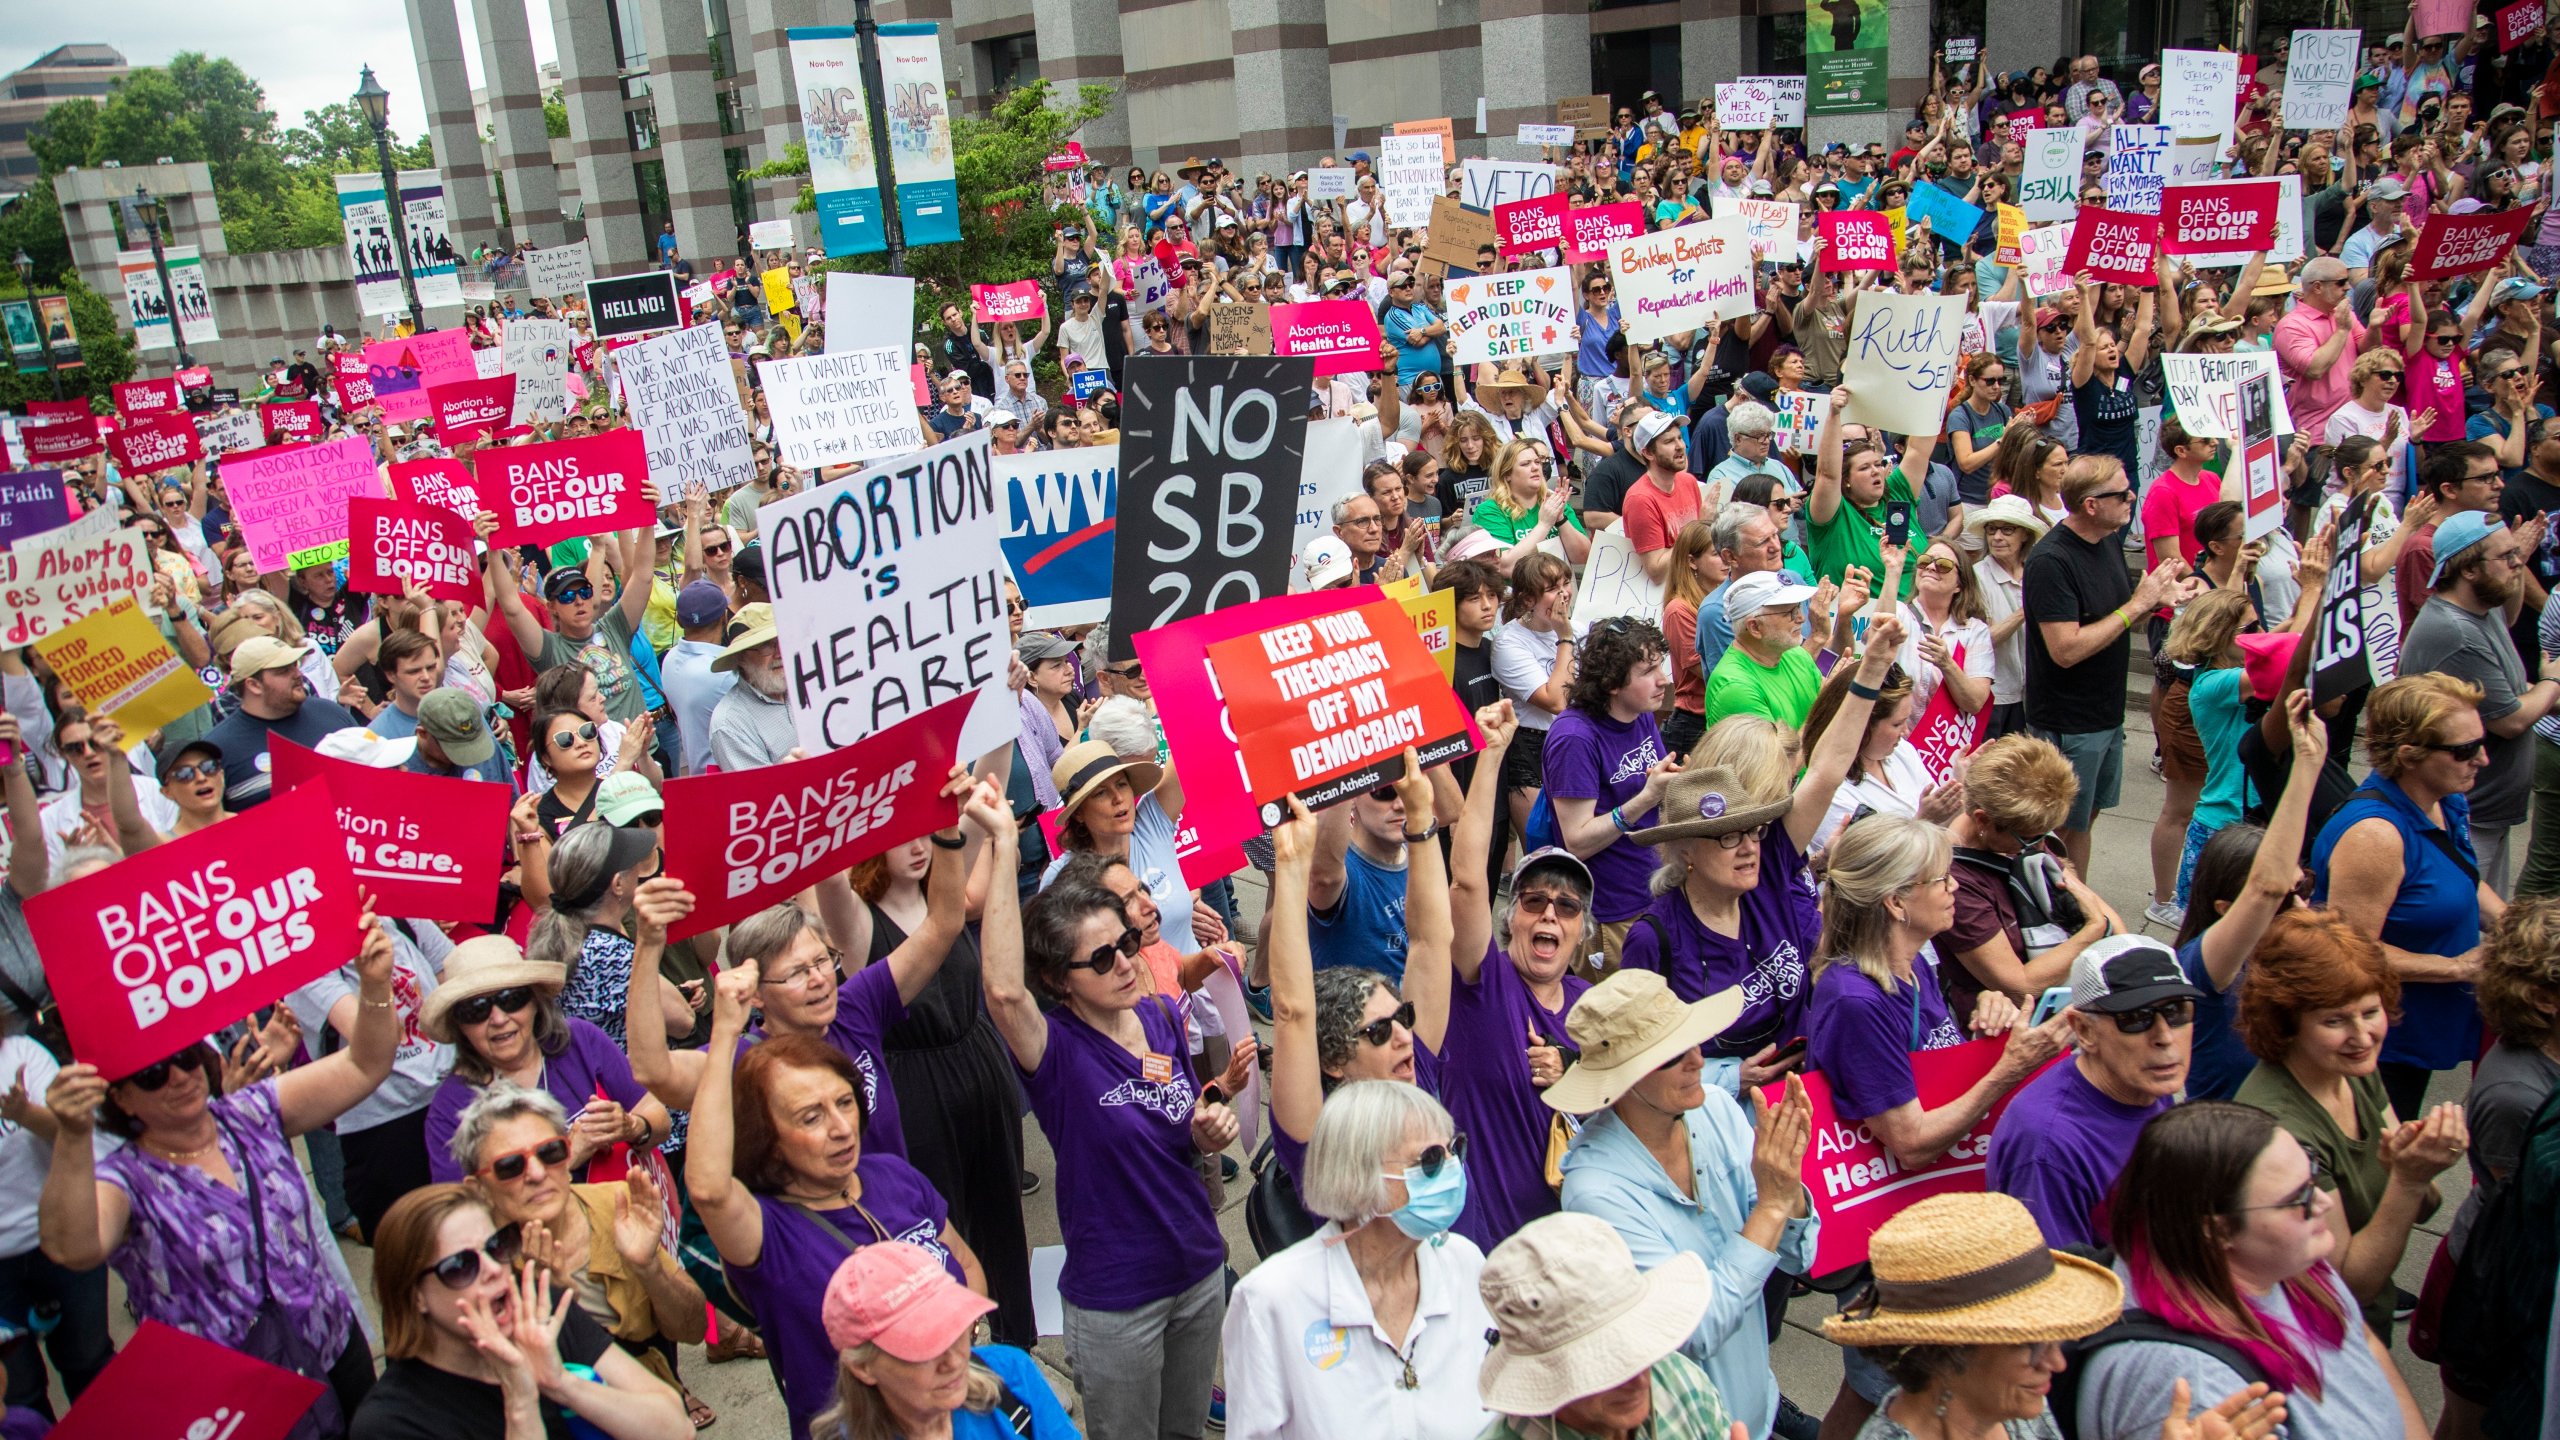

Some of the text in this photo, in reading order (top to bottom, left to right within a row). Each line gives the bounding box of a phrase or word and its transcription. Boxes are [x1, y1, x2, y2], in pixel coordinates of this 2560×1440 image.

[2295, 35, 2359, 60] TRUST
[809, 60, 843, 68] Now Open
[2292, 62, 2352, 81] WOMEN
[808, 87, 857, 117] NC
[1717, 84, 1773, 106] HER BODY
[1731, 101, 1751, 111] HER
[1721, 112, 1765, 124] CHOICE
[2285, 103, 2347, 123] DOCTORS
[1384, 136, 1440, 150] It's so bad
[2116, 126, 2171, 151] ALL I
[1388, 152, 1441, 166] that even the
[2110, 150, 2162, 174] WANT
[1385, 168, 1445, 185] INTROVERTS
[1388, 185, 1419, 197] are out
[1468, 168, 1553, 208] VETO
[2023, 175, 2073, 203] YIKES
[2110, 176, 2127, 193] FOR
[2108, 192, 2143, 208] DAY IS
[2180, 197, 2229, 213] BANS
[350, 205, 387, 226] SIGNS TIMES
[2178, 210, 2259, 228] OFF OUR
[2178, 225, 2250, 243] BODIES
[1620, 235, 1725, 277] Binkley Baptists
[1486, 279, 1525, 298] KEEP
[1671, 269, 1695, 285] for
[602, 295, 665, 319] HELL NO!
[1638, 274, 1748, 318] Reproductive Health
[1213, 306, 1253, 317] WOMENS
[1216, 316, 1250, 326] RIGHTS
[1450, 299, 1569, 338] REPRODUCTIVE
[1212, 333, 1240, 342] HUMAN
[1221, 325, 1233, 333] ARE
[1289, 319, 1351, 338] Abortion is
[1290, 333, 1370, 352] Health Care.
[1487, 320, 1532, 340] CARE
[1853, 306, 1953, 370] Ruth
[417, 337, 458, 352] BELIEVE
[420, 351, 446, 364] DATA
[619, 325, 720, 368] ROE WADE
[1488, 337, 1534, 356] SAFE!
[426, 359, 471, 376] DOCTORS
[628, 345, 726, 386] WAS NOT THE
[775, 351, 901, 383] IF I WANTED THE
[637, 369, 717, 404] BEGINNING
[799, 378, 887, 405] GOVERNMENT
[1078, 380, 1104, 389] 12-WEEK
[636, 388, 734, 427] OF ABORTIONS.
[790, 402, 899, 432] IN MY UTERUS
[656, 403, 745, 444] IT WAS THE
[1170, 384, 1278, 464] NO
[123, 429, 161, 448] BANS
[126, 432, 188, 458] OFF OUR
[646, 427, 750, 471] END OF WOMEN
[789, 428, 923, 462] I'D A SENATOR
[131, 446, 187, 468] BODIES
[252, 444, 344, 479] ABORTION
[677, 458, 723, 479] DYING
[232, 459, 373, 504] A PERSONAL DECISION
[508, 456, 579, 490] BANS
[713, 466, 755, 488] THEM!
[2, 484, 54, 502] Faith
[240, 500, 299, 524] BETWEEN
[303, 496, 312, 509] A
[317, 481, 366, 504] WOMAN
[510, 472, 625, 508] OFF OUR
[286, 517, 310, 532] HER
[515, 495, 617, 527] BODIES
[771, 443, 994, 599] ABORTION
[1147, 472, 1264, 563] SB
[376, 516, 443, 541] BANS
[35, 539, 132, 580] Aborto
[257, 541, 284, 560] NOT
[374, 537, 473, 573] OFF OUR
[376, 557, 469, 586] BODIES
[860, 564, 900, 601] is
[8, 566, 148, 609] es cuidado
[1149, 570, 1260, 631] 20
[109, 599, 133, 616] ACLU
[7, 610, 47, 643] de
[794, 569, 1001, 710] HEALTH
[1259, 610, 1372, 664] KEEP YOUR
[46, 637, 88, 669] STOP
[60, 646, 125, 687] FORCED
[74, 645, 177, 704] PREGNANCY.
[100, 659, 181, 713] ABORTION ACCESS FOR ALL
[1271, 641, 1390, 702] THEOCRACY
[822, 632, 993, 750] CARE
[1307, 678, 1389, 733] OFF MY
[1290, 705, 1426, 781] DEMOCRACY
[725, 759, 917, 866] OFF OUR
[729, 767, 858, 836] BANS
[727, 795, 895, 899] BODIES
[97, 860, 236, 950] BANS
[113, 866, 324, 987] OFF OUR
[127, 910, 315, 1030] BODIES
